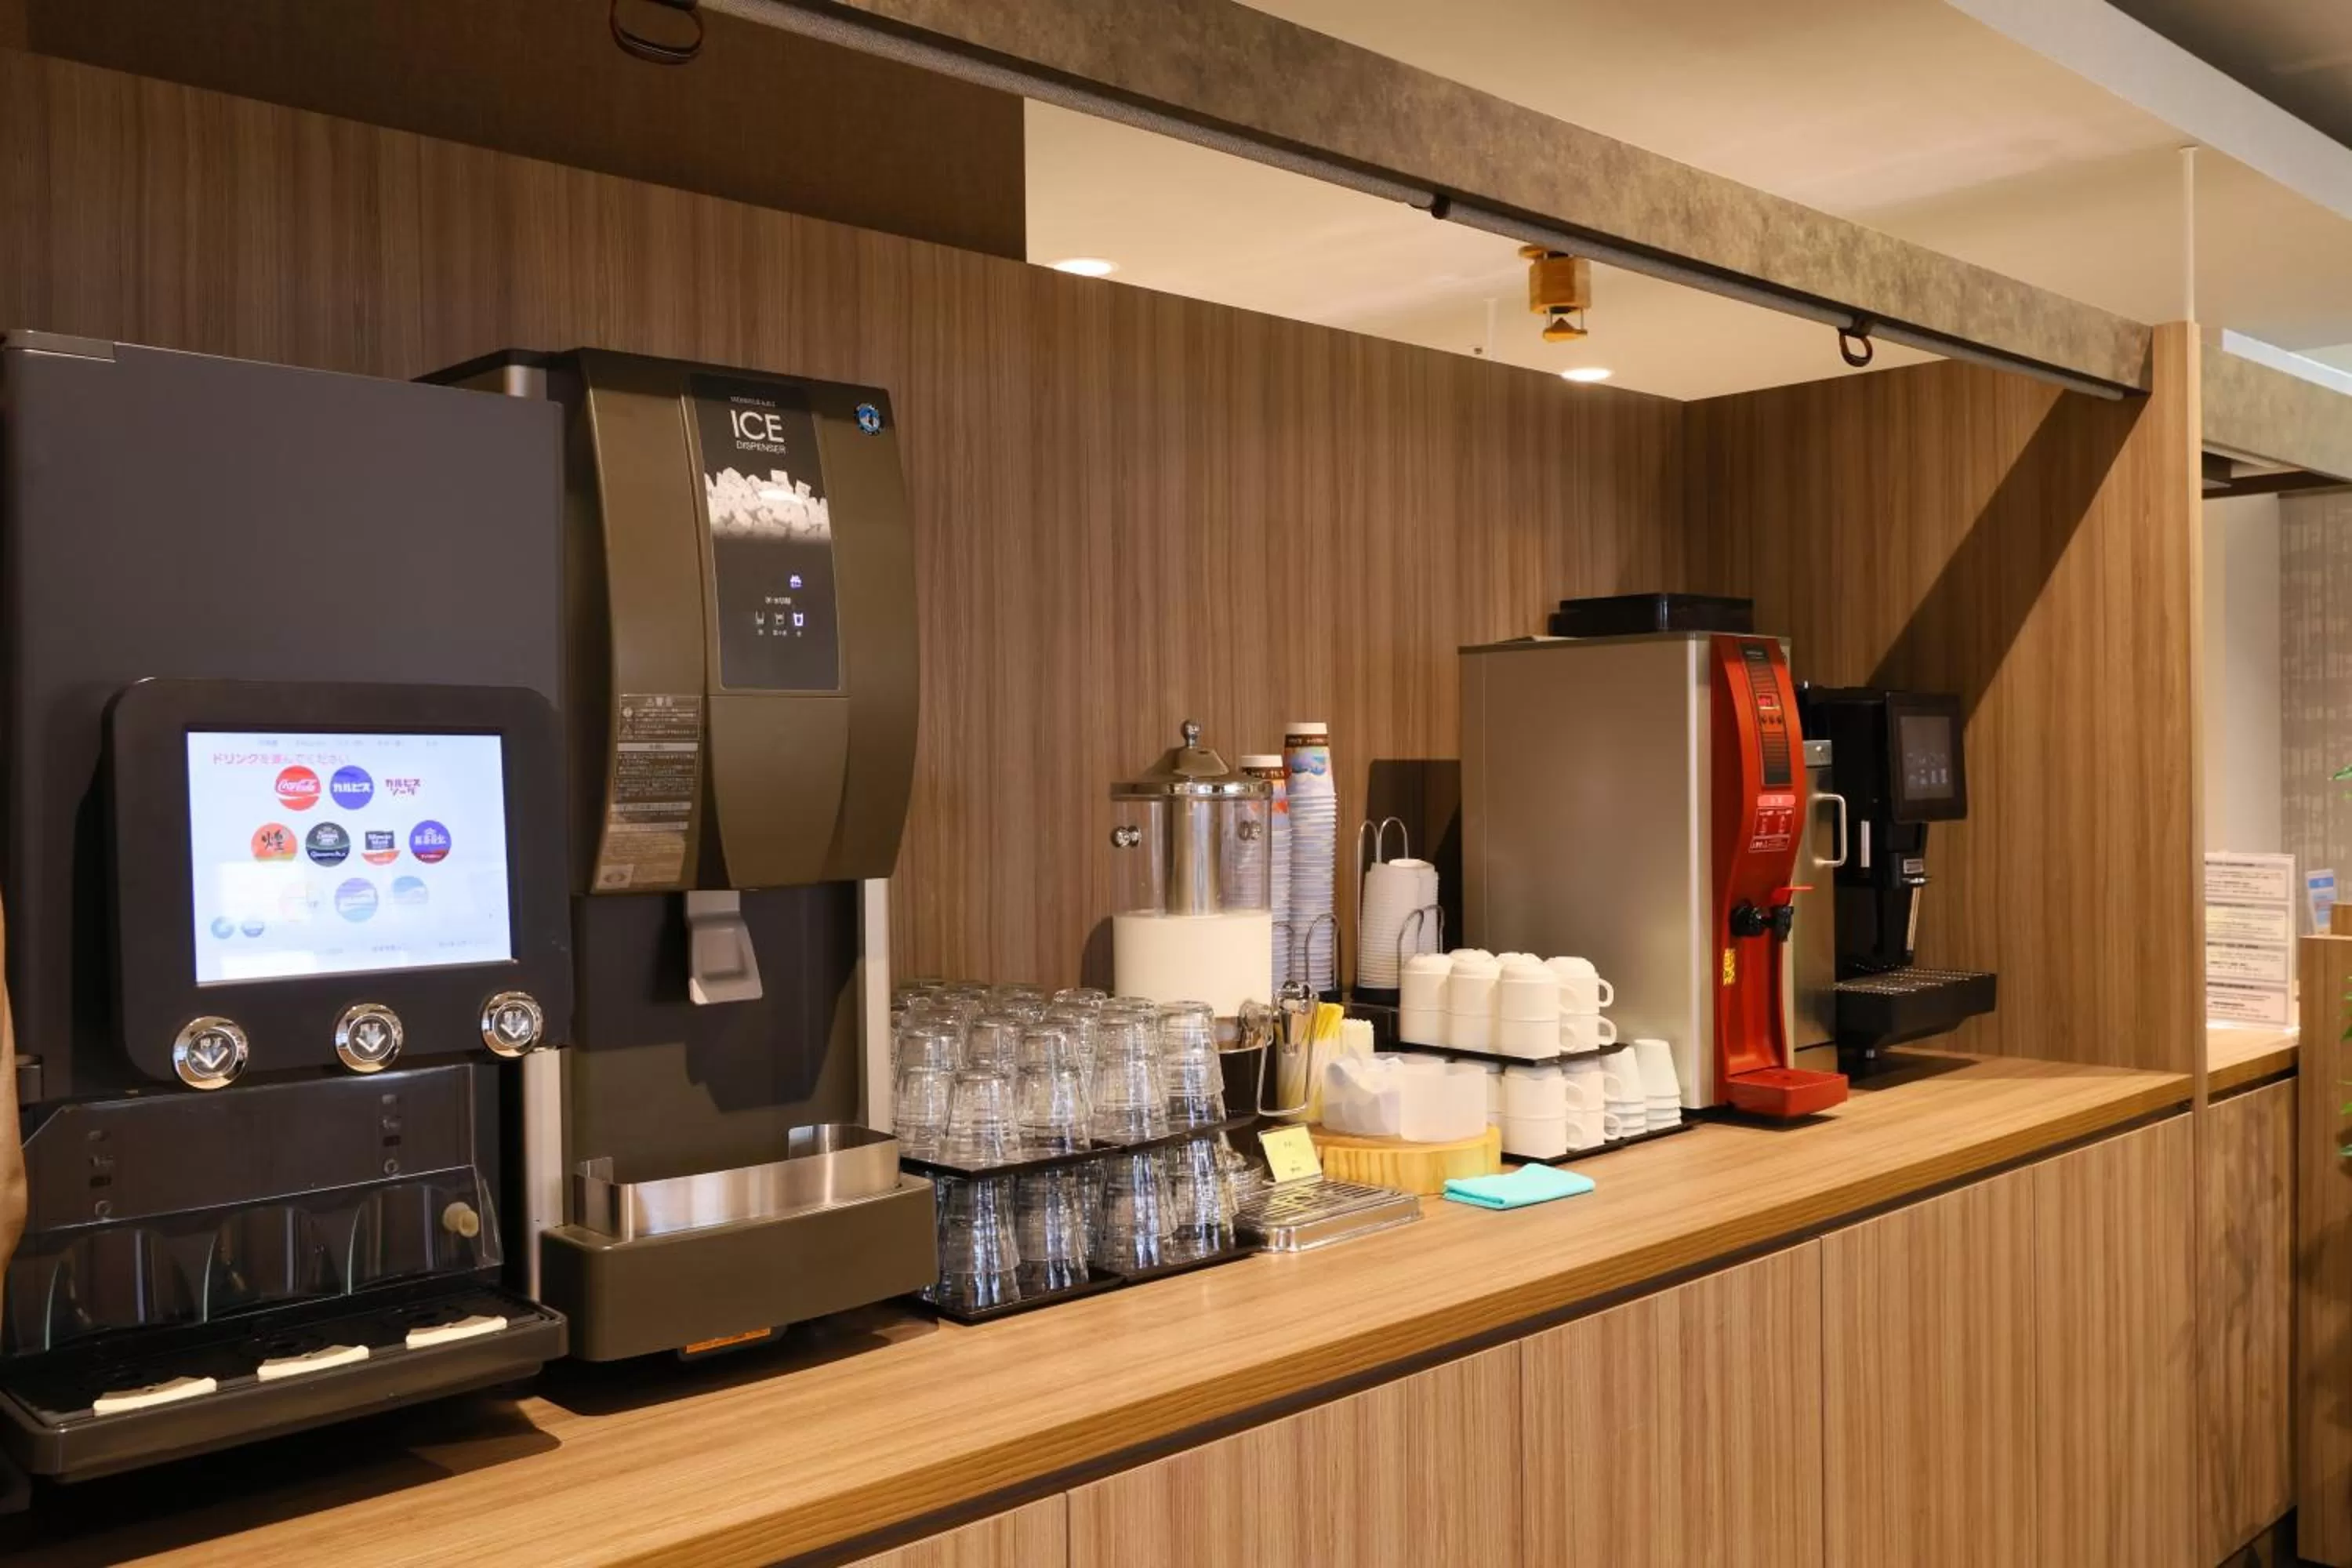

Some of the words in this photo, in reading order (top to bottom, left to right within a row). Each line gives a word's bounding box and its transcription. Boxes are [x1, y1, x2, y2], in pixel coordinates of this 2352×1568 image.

[731, 409, 785, 442] ICE
[736, 440, 787, 455] DISPENSER
[333, 782, 372, 793] カルピス
